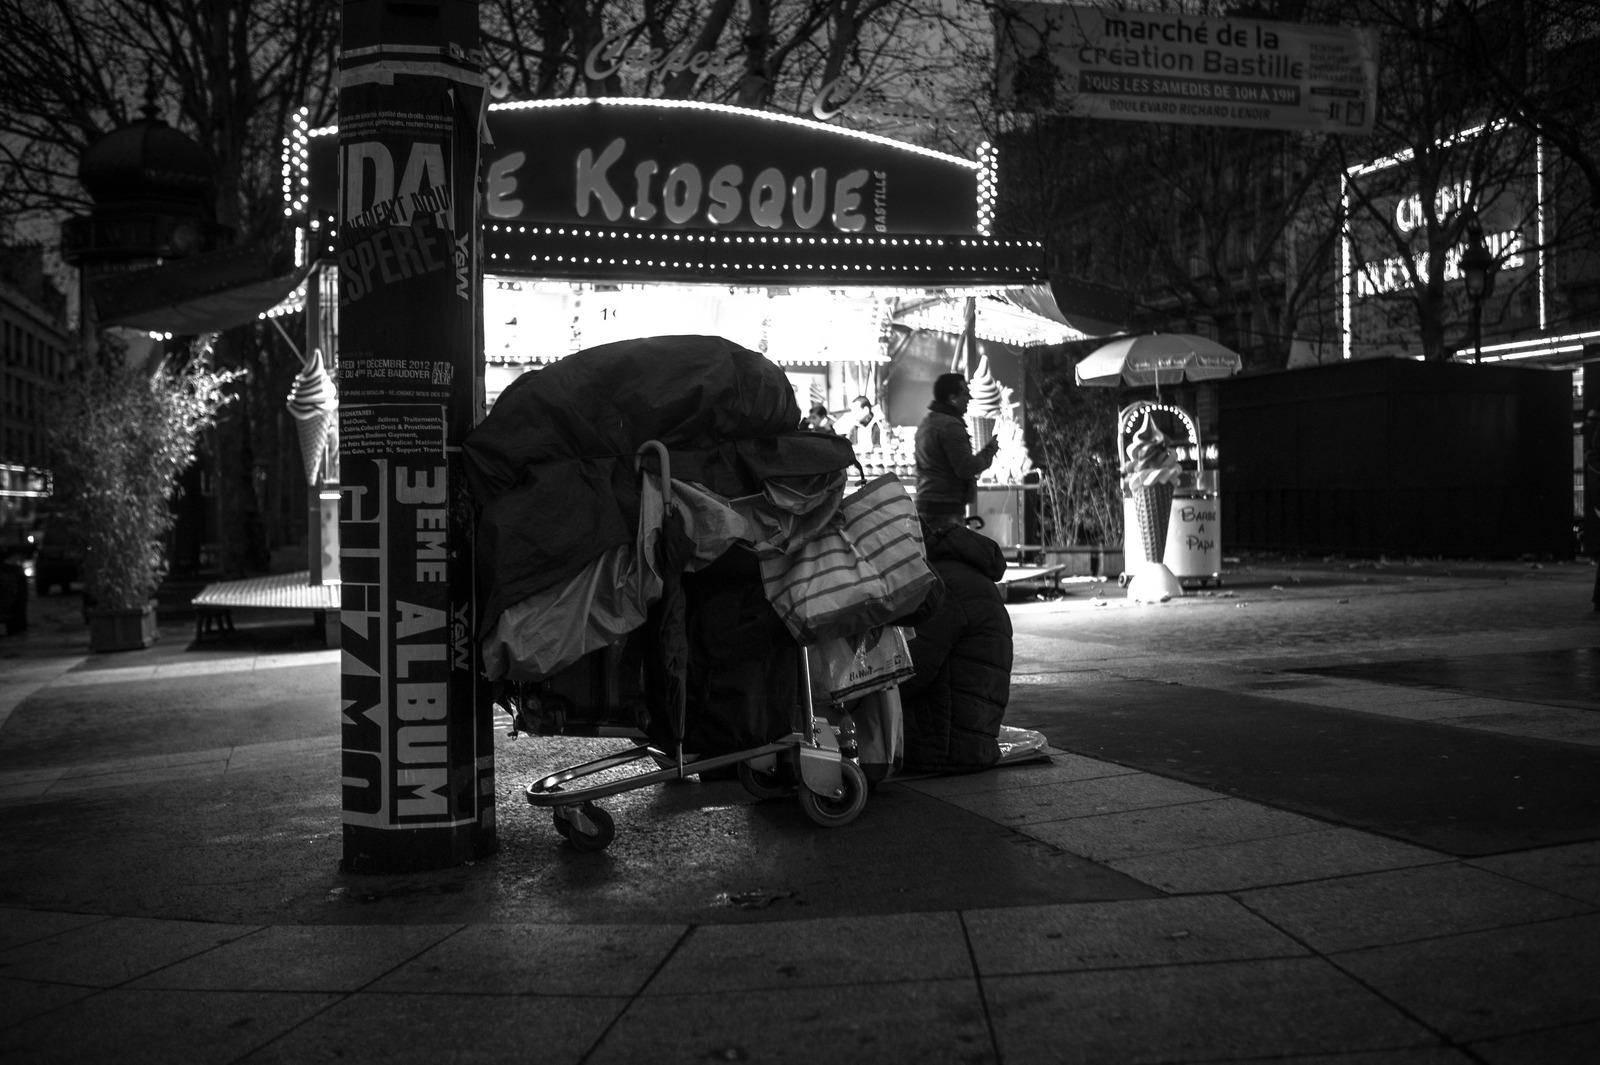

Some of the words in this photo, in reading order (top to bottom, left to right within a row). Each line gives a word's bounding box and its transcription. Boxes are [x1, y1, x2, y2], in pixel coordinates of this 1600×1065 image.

[1105, 18, 1208, 45] marché
[1216, 23, 1247, 47] de
[1256, 26, 1279, 49] la
[1204, 50, 1303, 80] Bastille
[1124, 77, 1149, 93] LES
[1152, 80, 1211, 98] SAMEDIS
[1214, 84, 1230, 99] DE
[1109, 99, 1177, 115] BOULEVARD
[1180, 104, 1228, 118] RICHARD
[1231, 106, 1271, 121] LENOIR
[575, 136, 870, 233] KIOSQUE
[872, 170, 888, 233] BASTILLE
[366, 358, 407, 369] DÉCEMBRE
[408, 360, 431, 370] 2012
[367, 369, 386, 378] PLACE
[388, 369, 431, 379] BAUDOYER
[396, 446, 422, 454] Support
[396, 600, 448, 816] ALBUM
